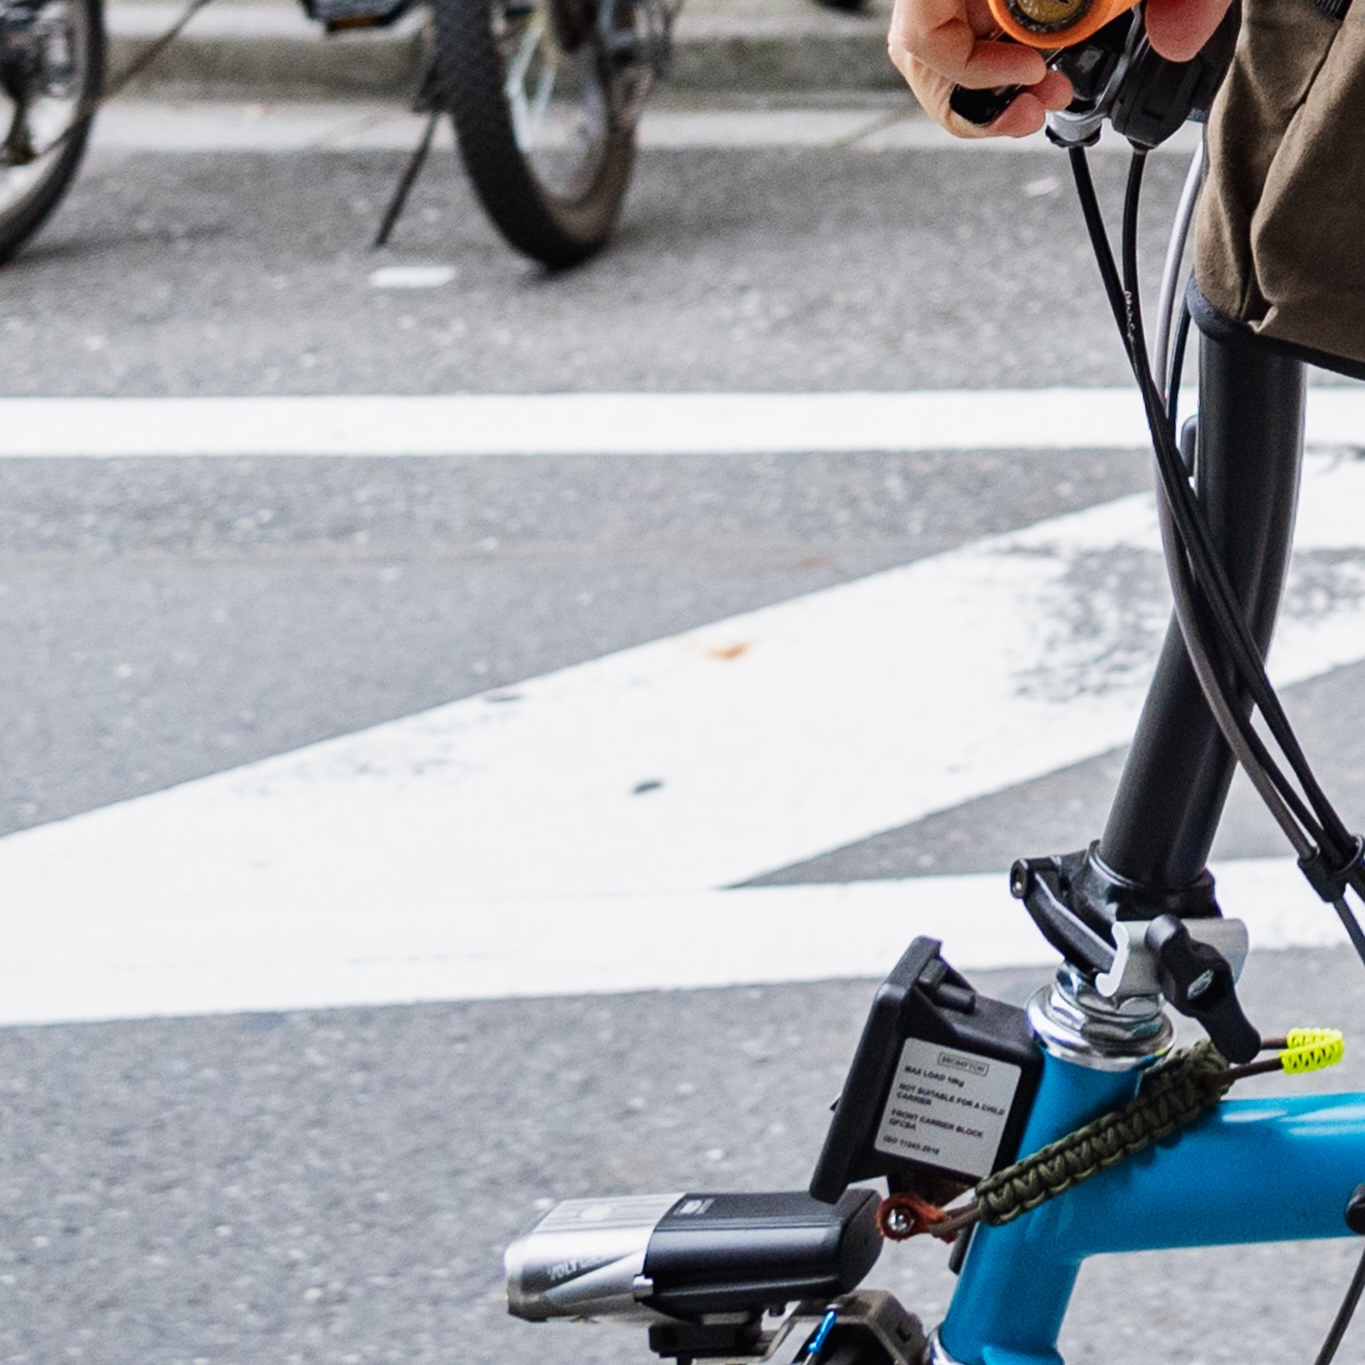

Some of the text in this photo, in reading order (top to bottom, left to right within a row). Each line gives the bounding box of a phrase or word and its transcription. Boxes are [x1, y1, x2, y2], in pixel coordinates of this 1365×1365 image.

[905, 1066, 922, 1077] MAX
[923, 1070, 946, 1082] LOAD
[897, 1091, 932, 1106] CARRIER
[900, 1083, 916, 1093] NOT
[917, 1086, 955, 1102] SUITABLE
[957, 1097, 973, 1108] FOR
[981, 1103, 1006, 1117] CHILD
[892, 1108, 984, 1138] FRONT CARRIER BLOCK
